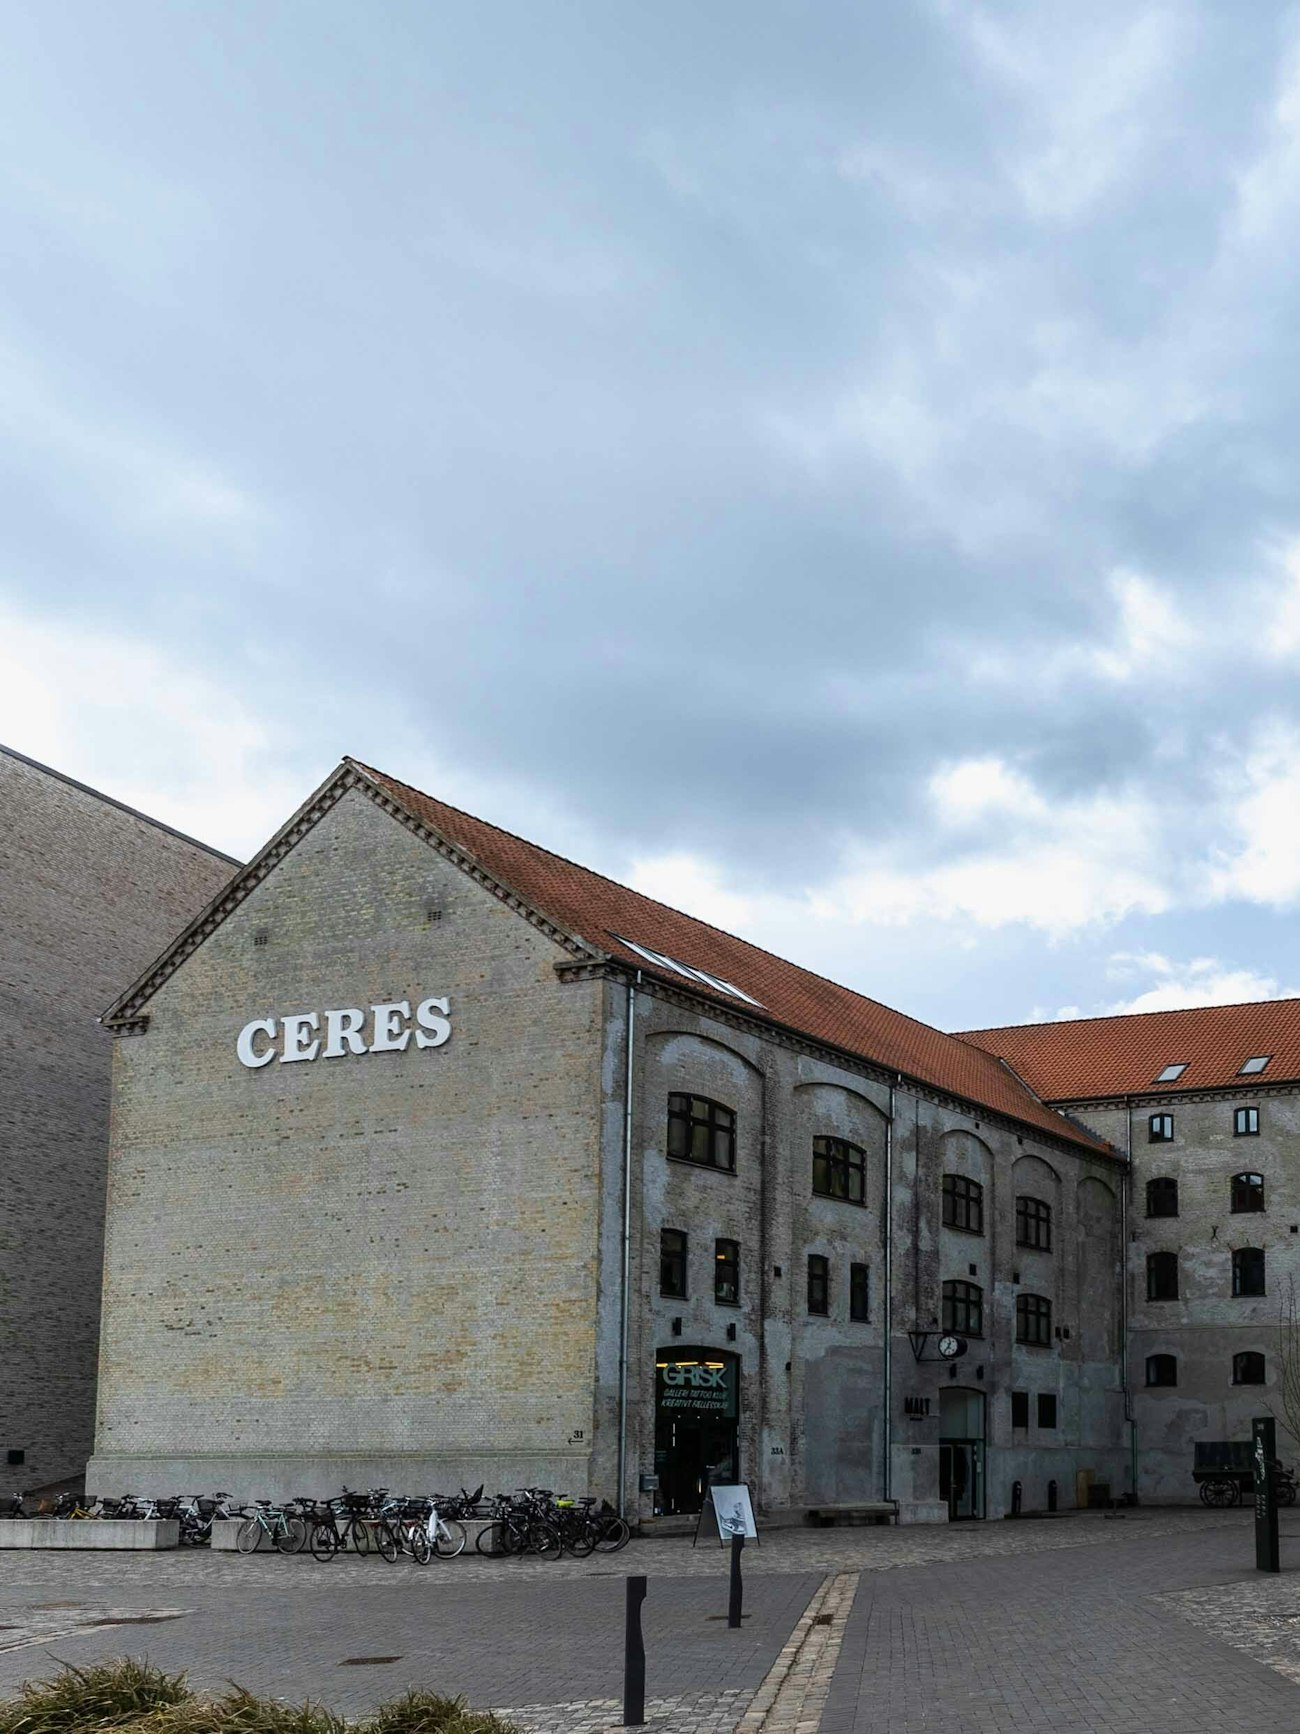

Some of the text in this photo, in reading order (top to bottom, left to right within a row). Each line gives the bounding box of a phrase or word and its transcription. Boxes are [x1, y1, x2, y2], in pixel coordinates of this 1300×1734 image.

[237, 997, 452, 1068] CERES
[662, 1362, 728, 1388] GRISK
[904, 1396, 931, 1416] MALT
[573, 1430, 584, 1439] 31
